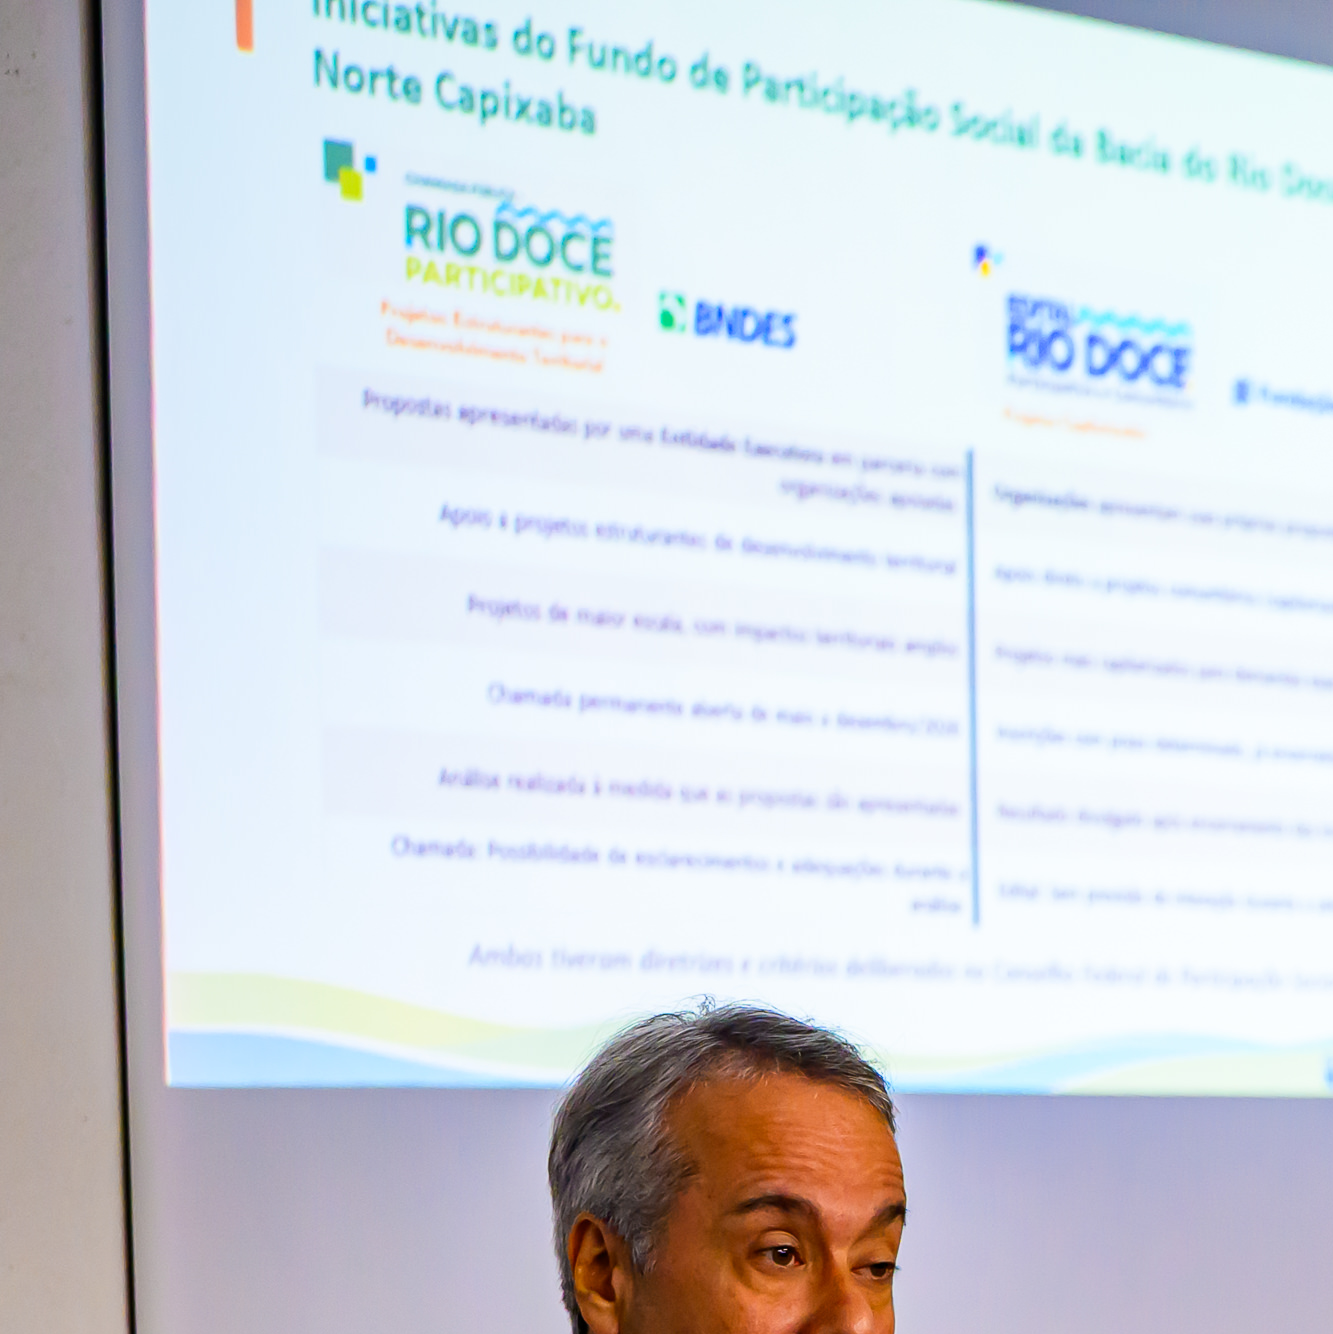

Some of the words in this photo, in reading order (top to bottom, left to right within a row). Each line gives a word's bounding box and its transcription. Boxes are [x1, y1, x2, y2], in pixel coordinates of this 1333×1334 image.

[313, 47, 422, 105] Norte
[433, 71, 596, 136] Capixaba
[511, 18, 555, 61] do
[567, 26, 677, 84] Fundo
[688, 53, 729, 94] de
[741, 60, 940, 133] Participação
[949, 101, 1039, 150] Social
[1049, 123, 1085, 159] da
[1095, 128, 1172, 175] Bacia
[405, 204, 481, 256] RIO
[493, 220, 615, 278] DOCE
[693, 300, 796, 349] BNDES
[1007, 322, 1074, 373] RIO
[1086, 333, 1191, 389] DOCE
[361, 388, 452, 419] Propostas
[456, 405, 578, 435] apresentadas
[582, 421, 612, 440] por
[618, 425, 654, 445] uma
[512, 513, 590, 539] projetos
[465, 593, 542, 621] Projetos
[487, 682, 573, 709] Chamada
[467, 943, 544, 970] Ambos
